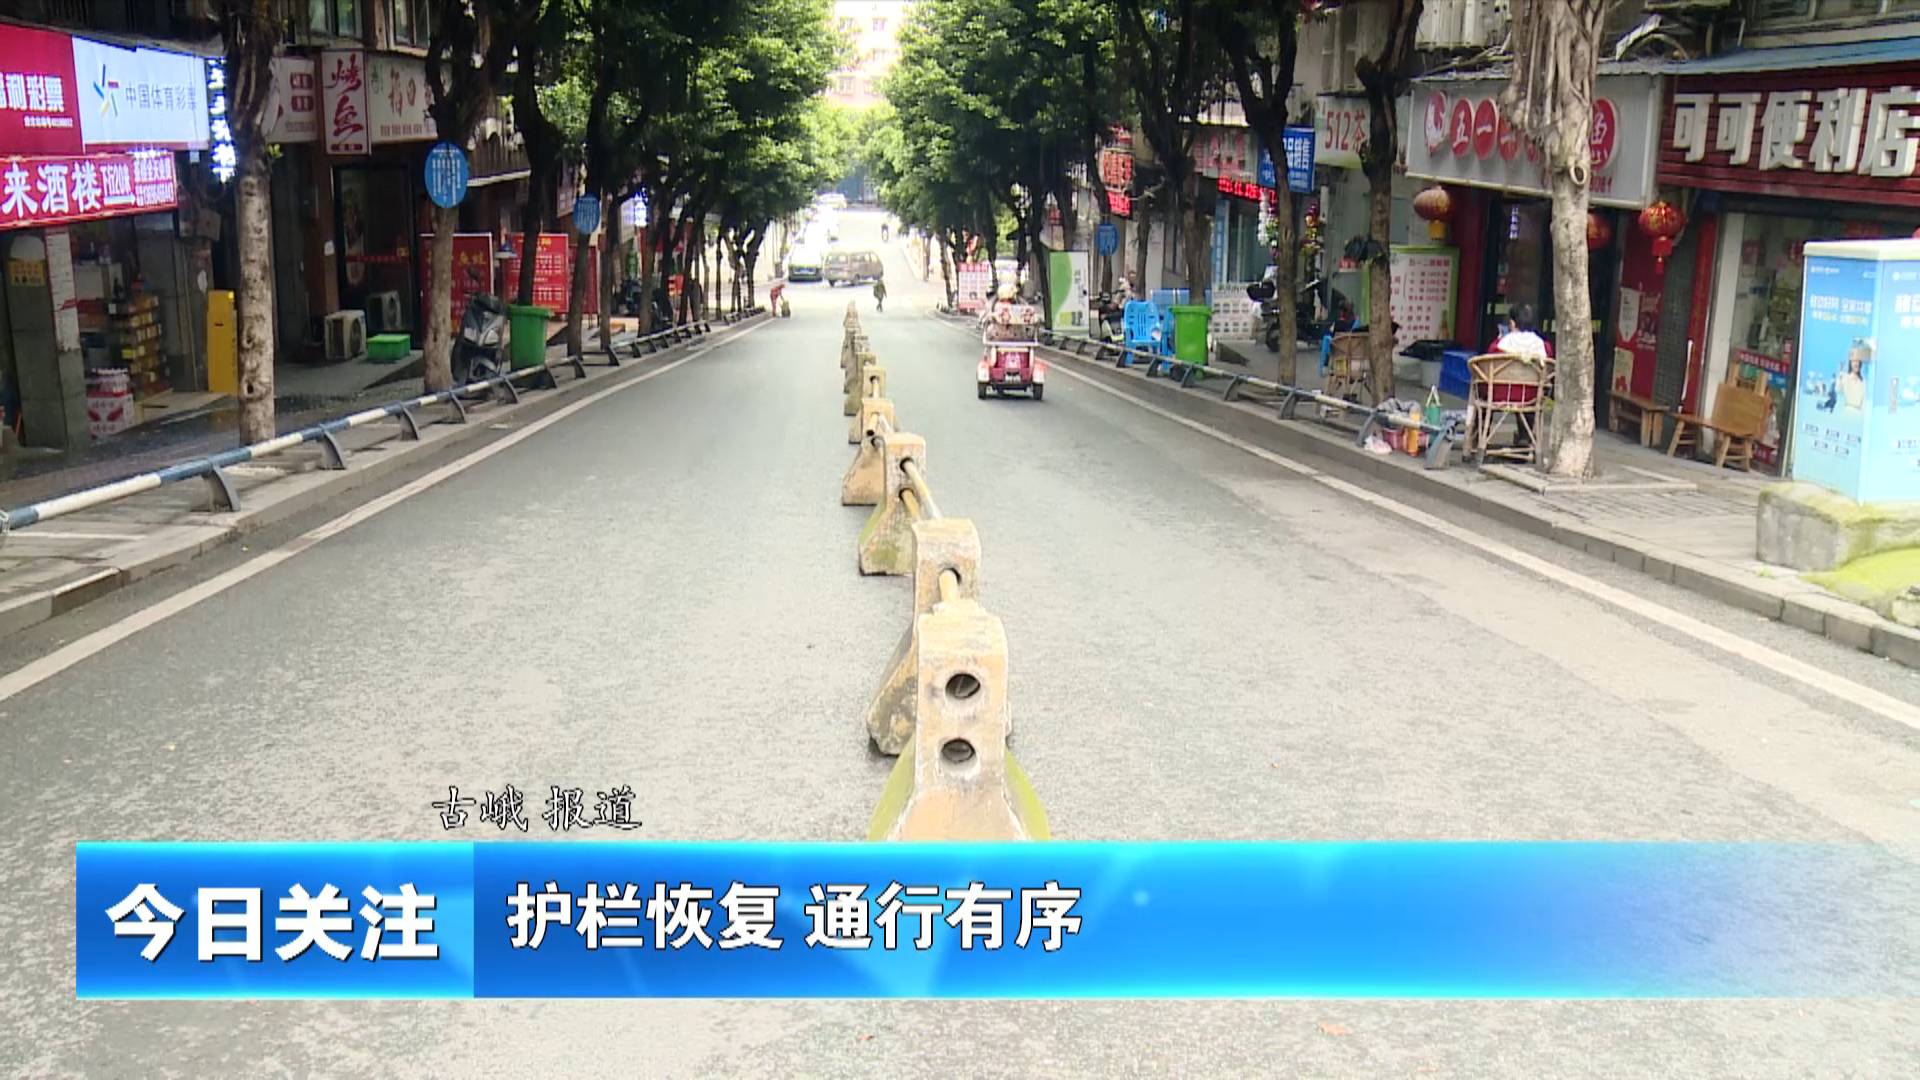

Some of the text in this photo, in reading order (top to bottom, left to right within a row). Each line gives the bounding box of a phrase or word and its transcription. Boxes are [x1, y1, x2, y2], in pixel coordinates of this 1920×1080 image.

[125, 82, 197, 111] 中国体育彩票
[1673, 86, 1920, 177] 可可便利店
[2, 161, 101, 218] 来酒楼
